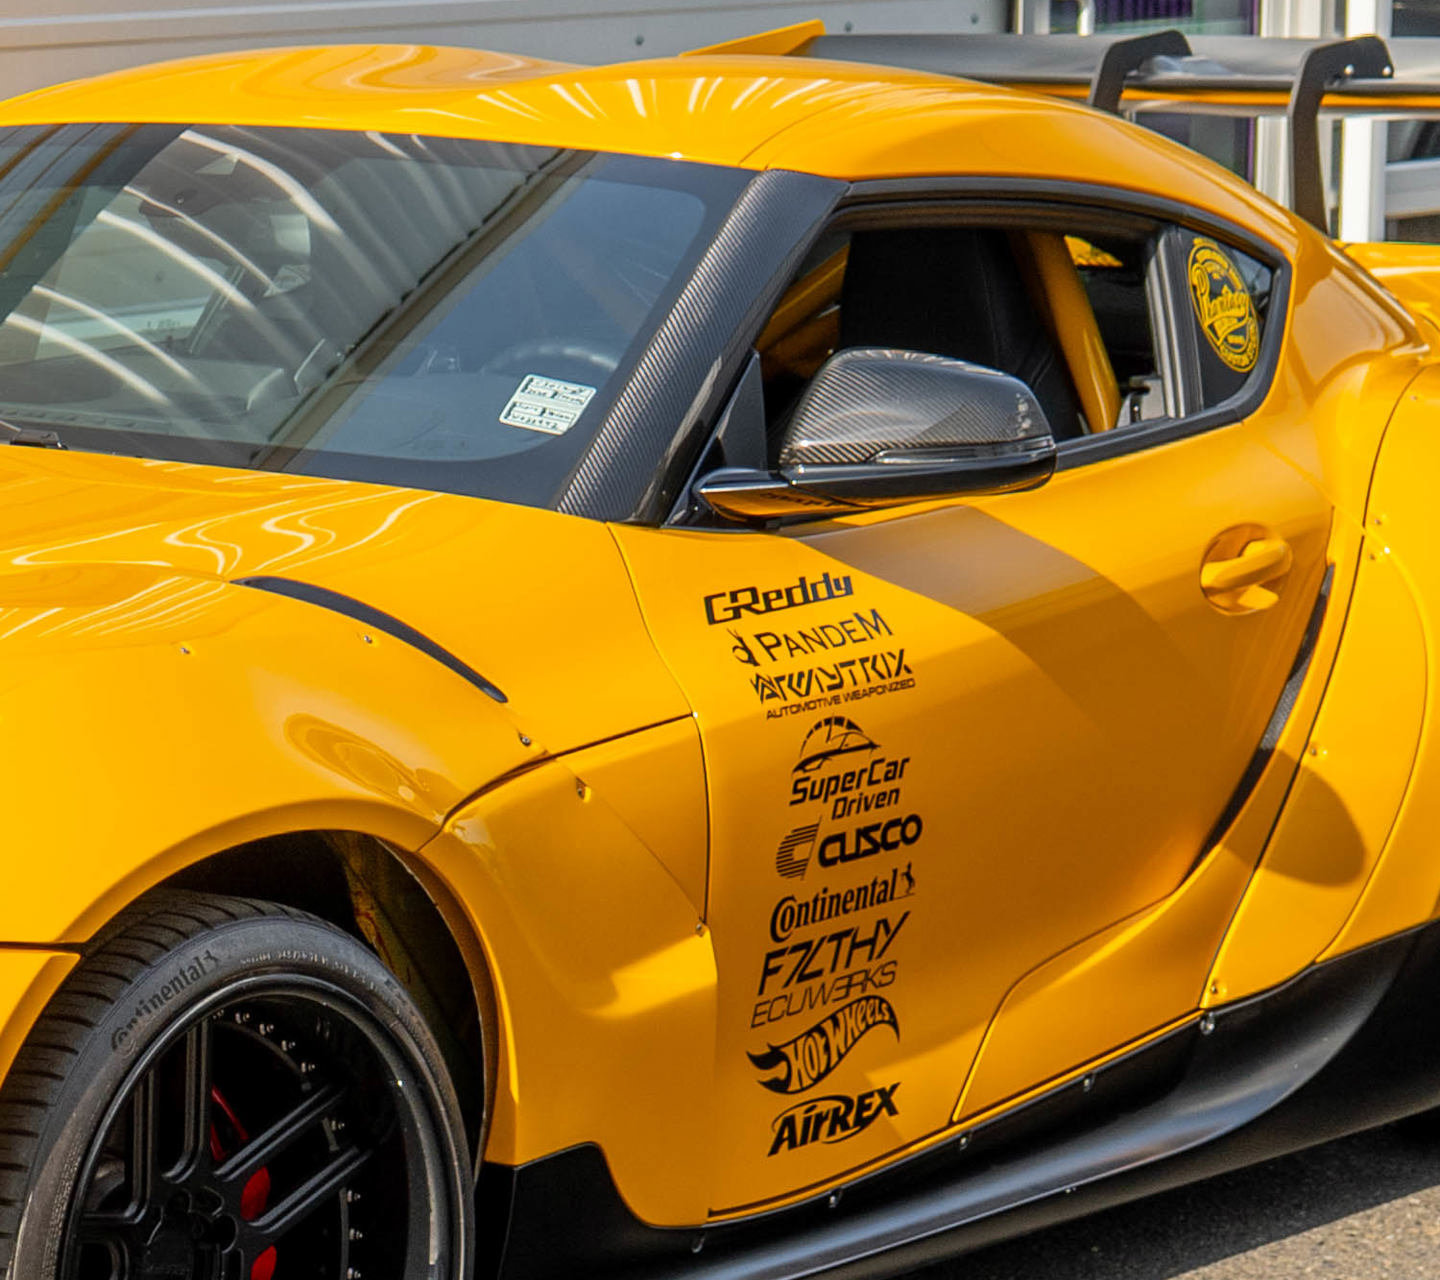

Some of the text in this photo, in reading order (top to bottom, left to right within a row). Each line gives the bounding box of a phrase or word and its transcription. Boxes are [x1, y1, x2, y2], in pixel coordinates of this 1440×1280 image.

[766, 677, 916, 720] AUTOMOTIVE WEAPONIZED
[789, 757, 911, 807] SuperCar
[831, 788, 900, 820] Driven
[818, 814, 923, 868] CUSCO
[770, 868, 897, 943] Continental
